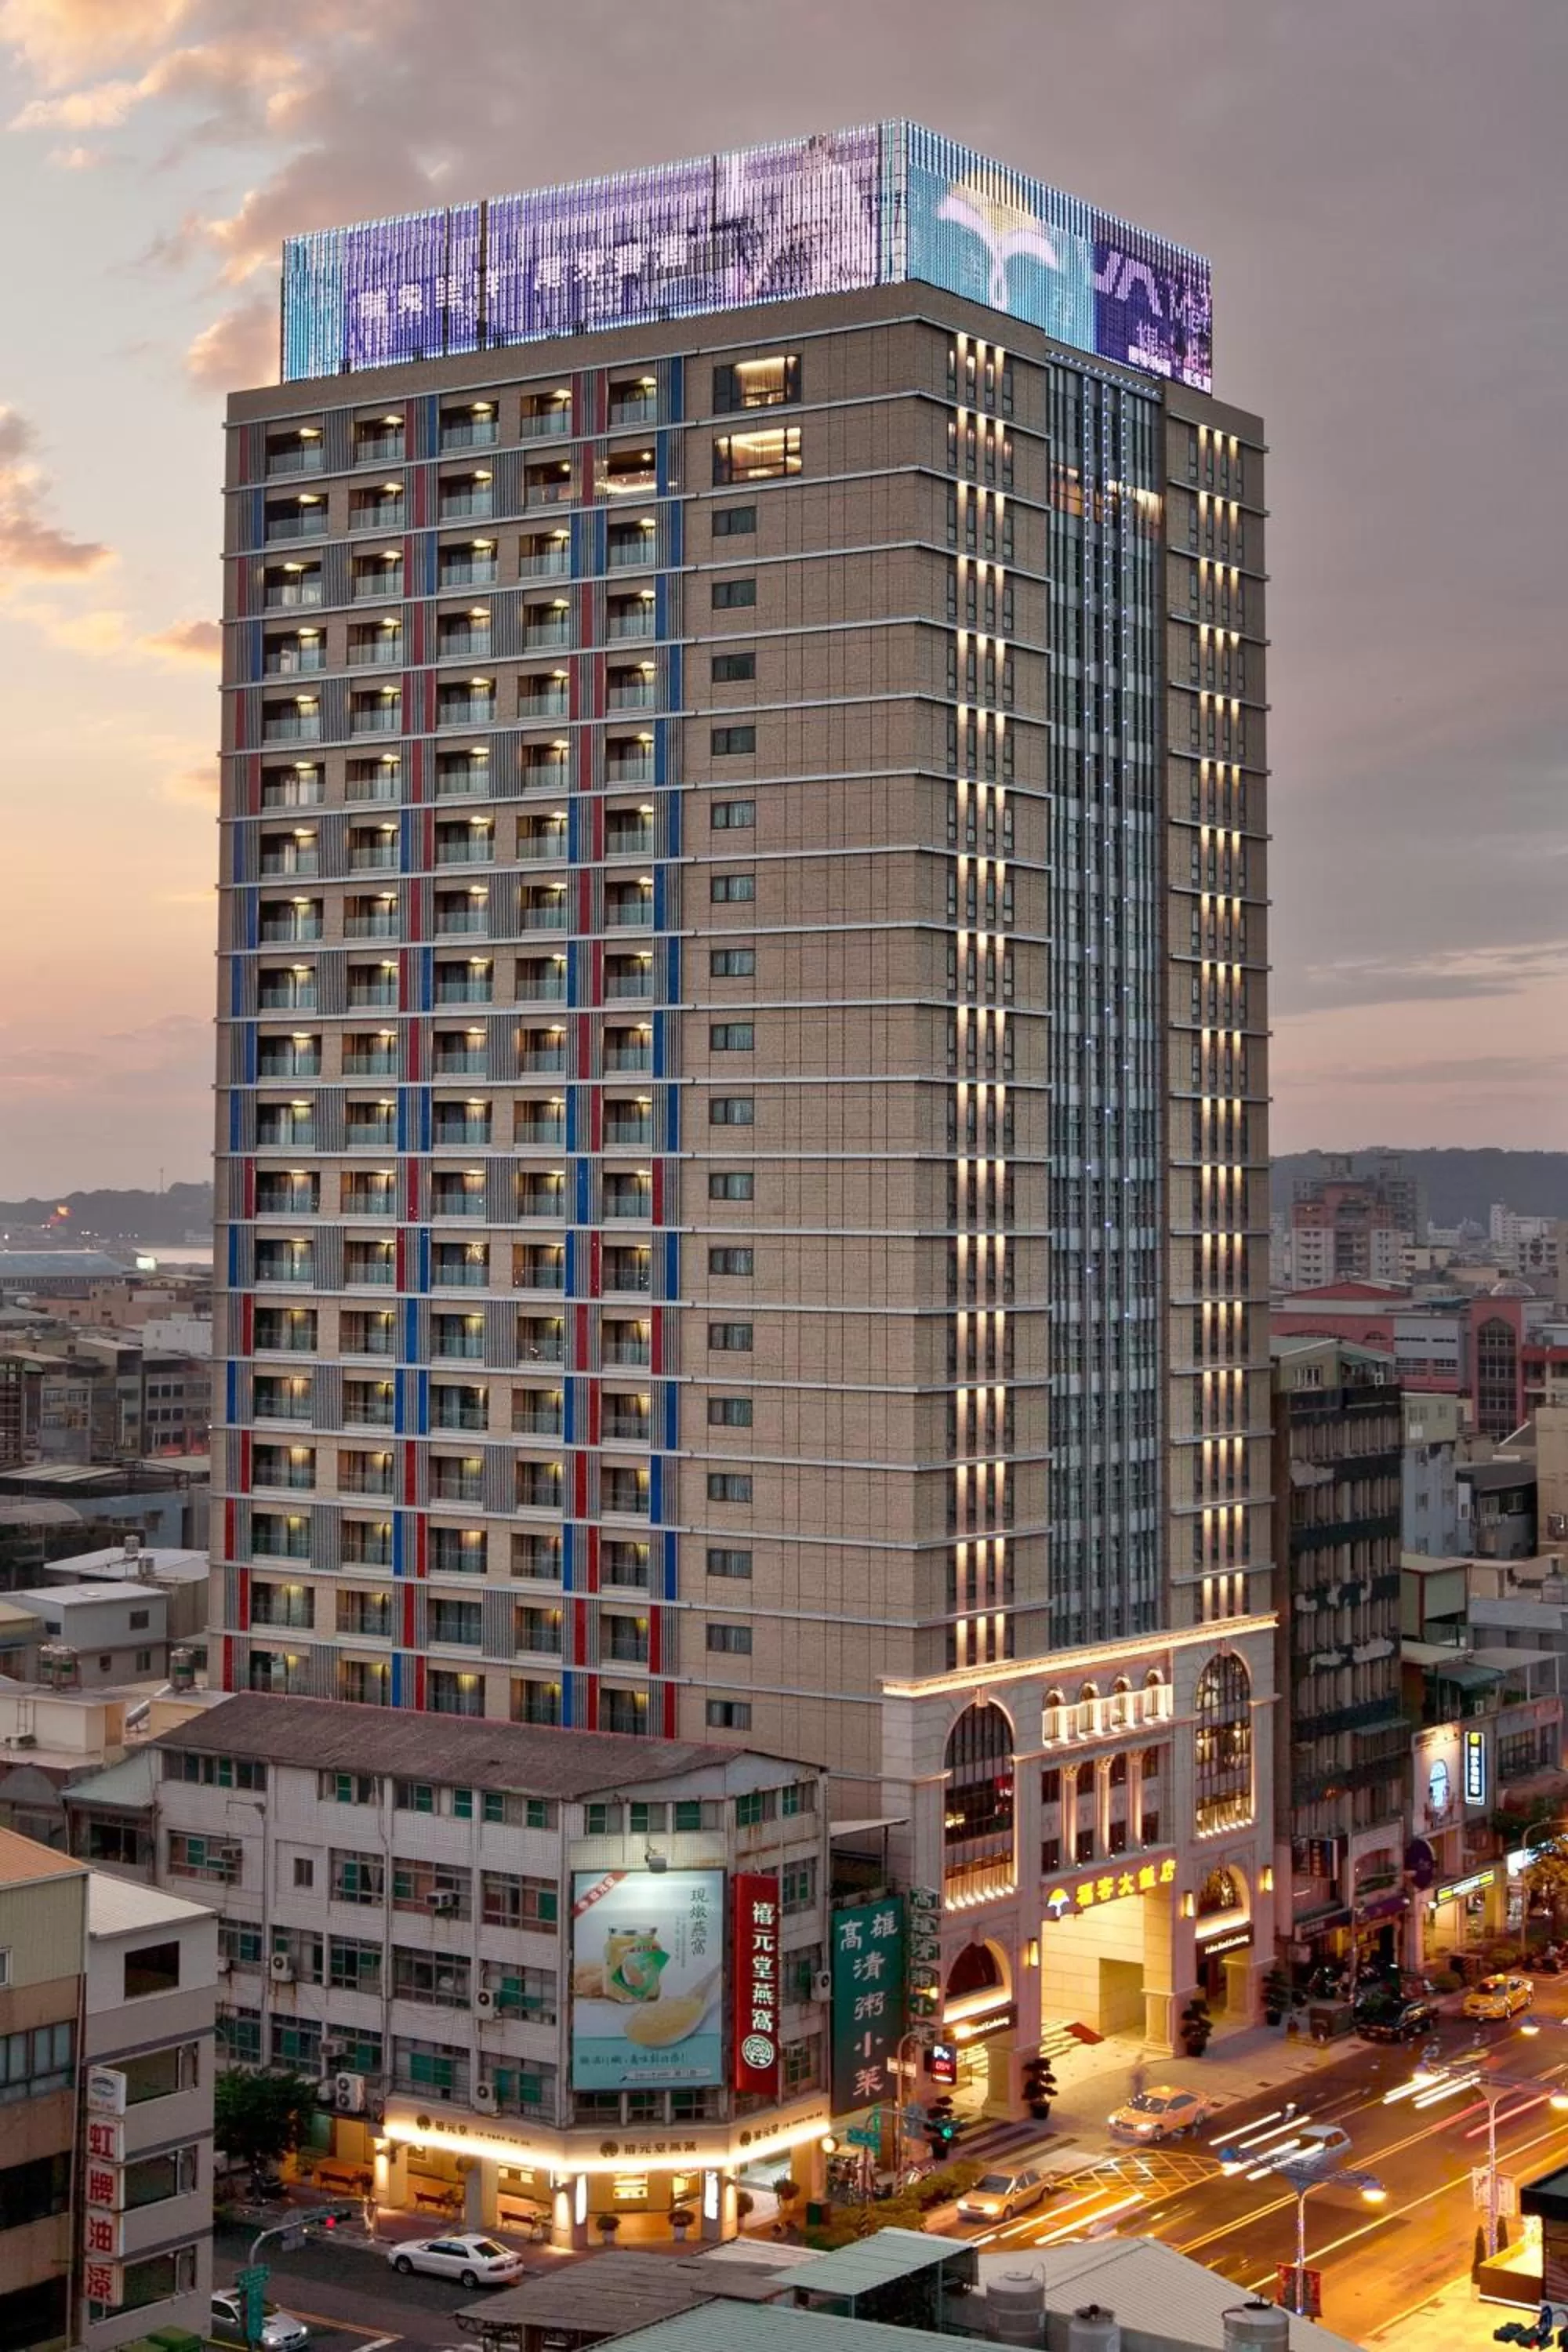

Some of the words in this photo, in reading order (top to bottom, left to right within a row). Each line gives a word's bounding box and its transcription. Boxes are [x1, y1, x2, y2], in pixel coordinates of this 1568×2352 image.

[751, 1901, 775, 2033] 禧元堂燕窩
[88, 2122, 115, 2303] 虹牌油漆
